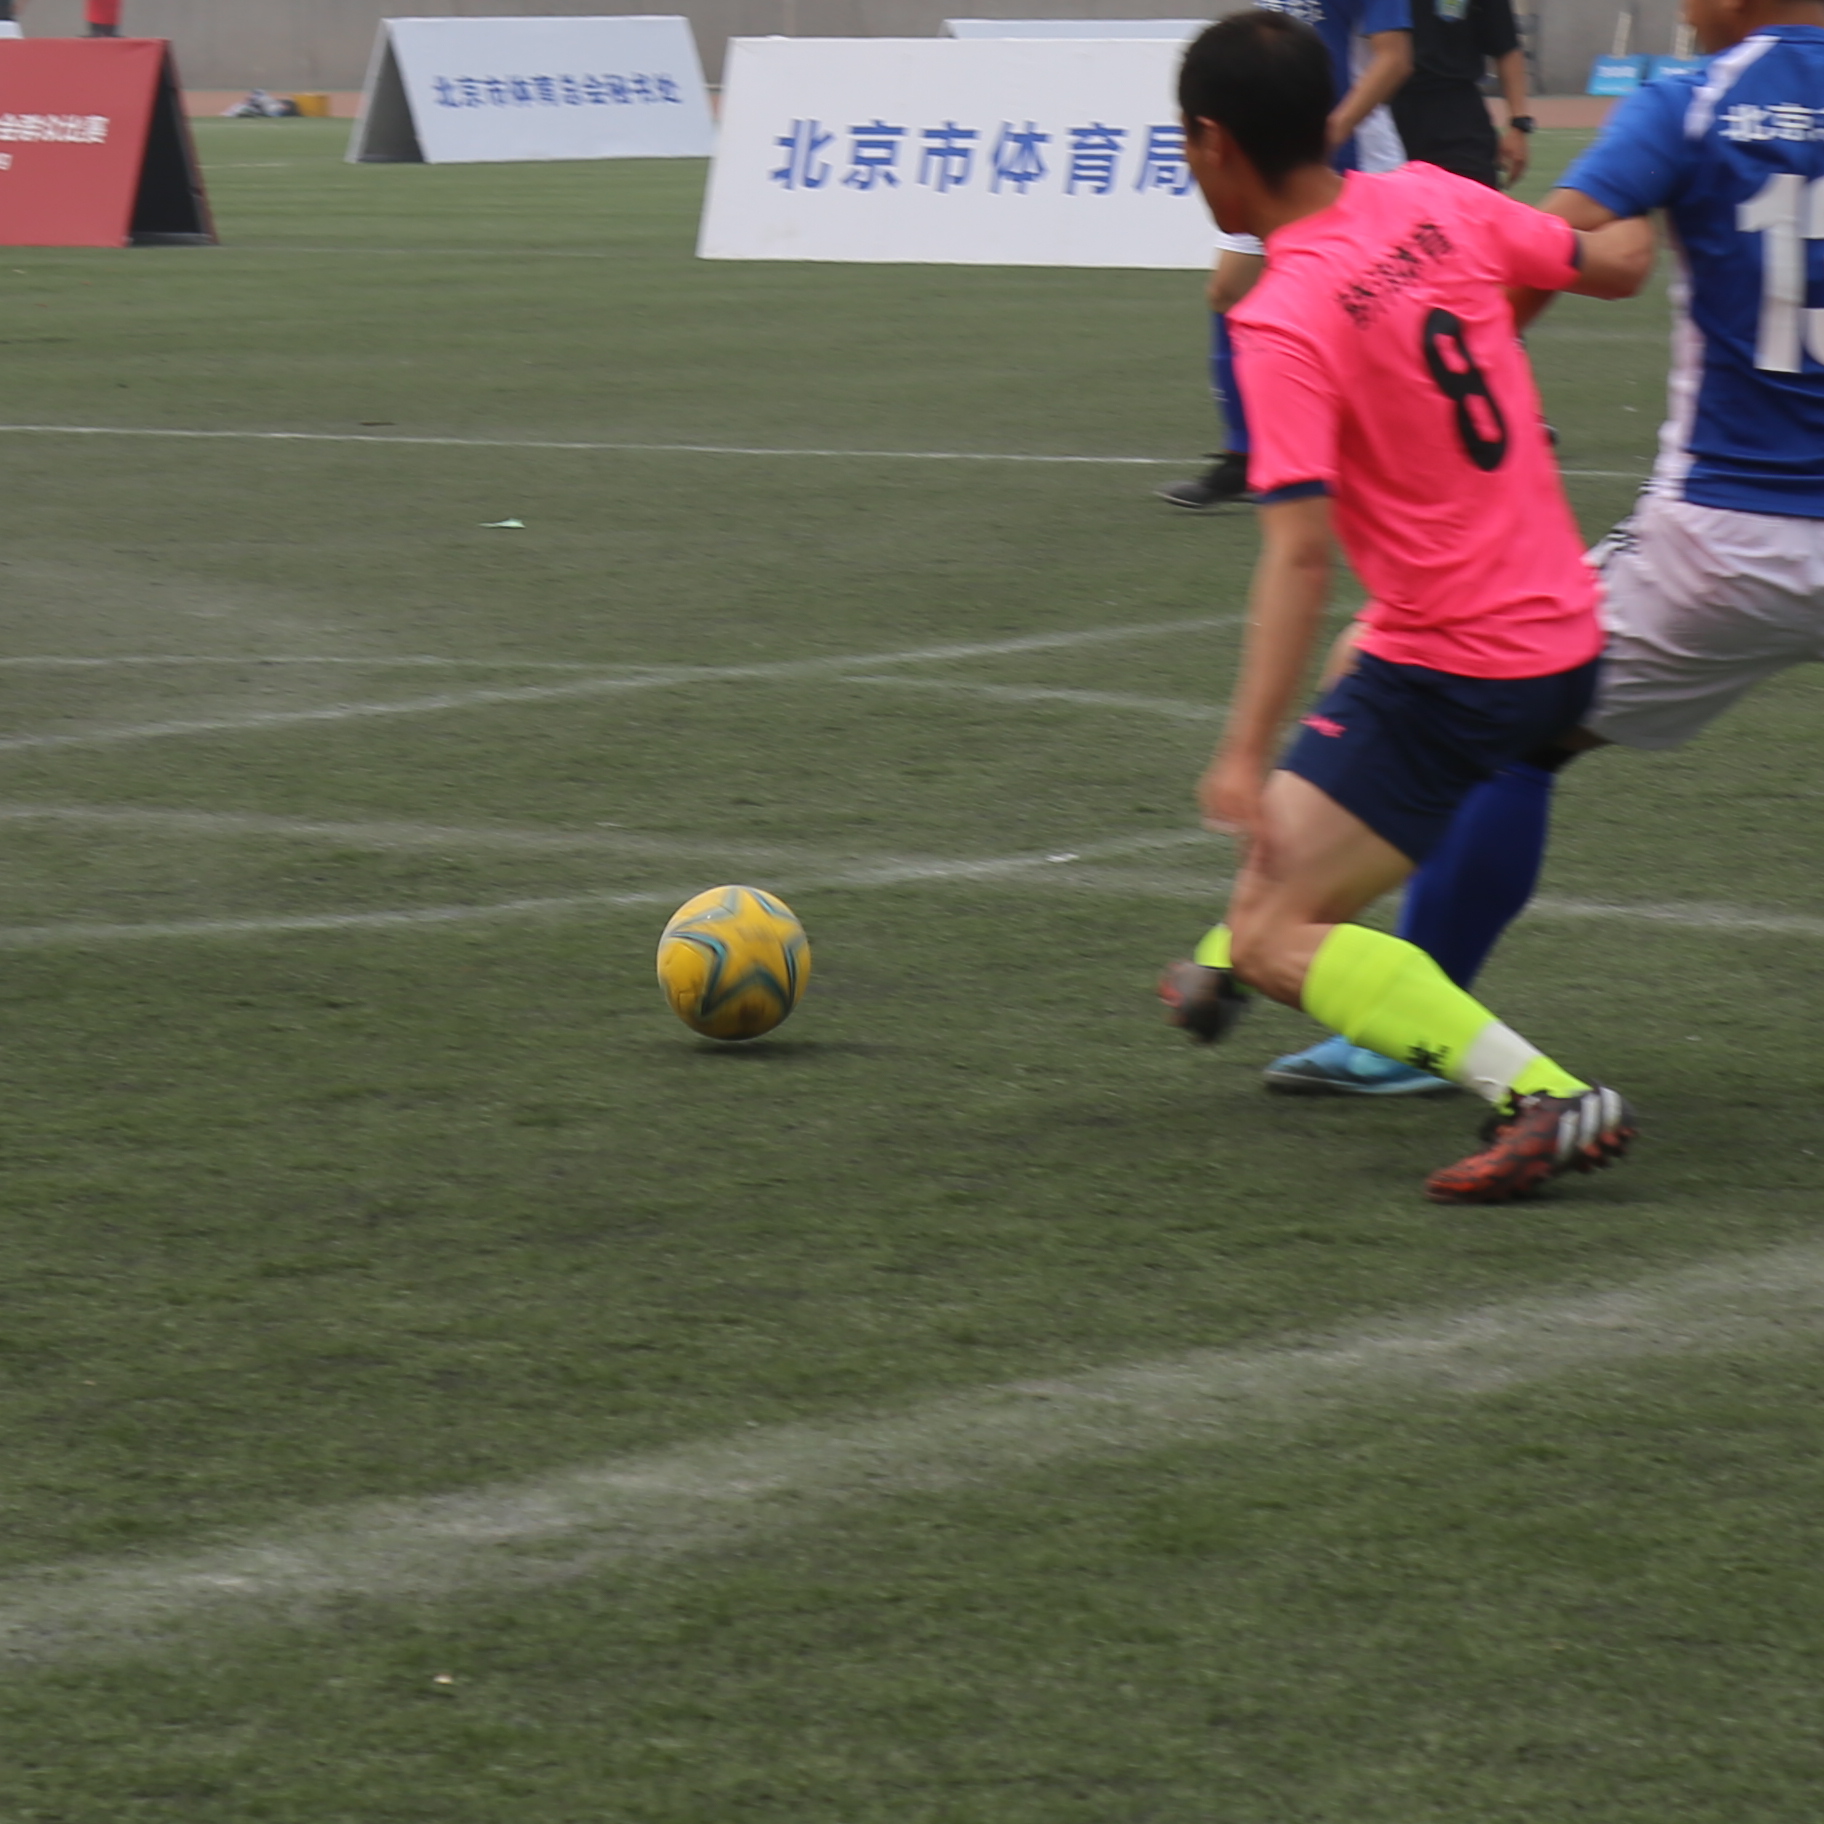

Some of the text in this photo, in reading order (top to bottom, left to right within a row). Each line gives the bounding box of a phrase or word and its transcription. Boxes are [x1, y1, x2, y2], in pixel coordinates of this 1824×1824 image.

[770, 119, 1194, 195] 北京市体育局
[1422, 307, 1508, 473] 8
